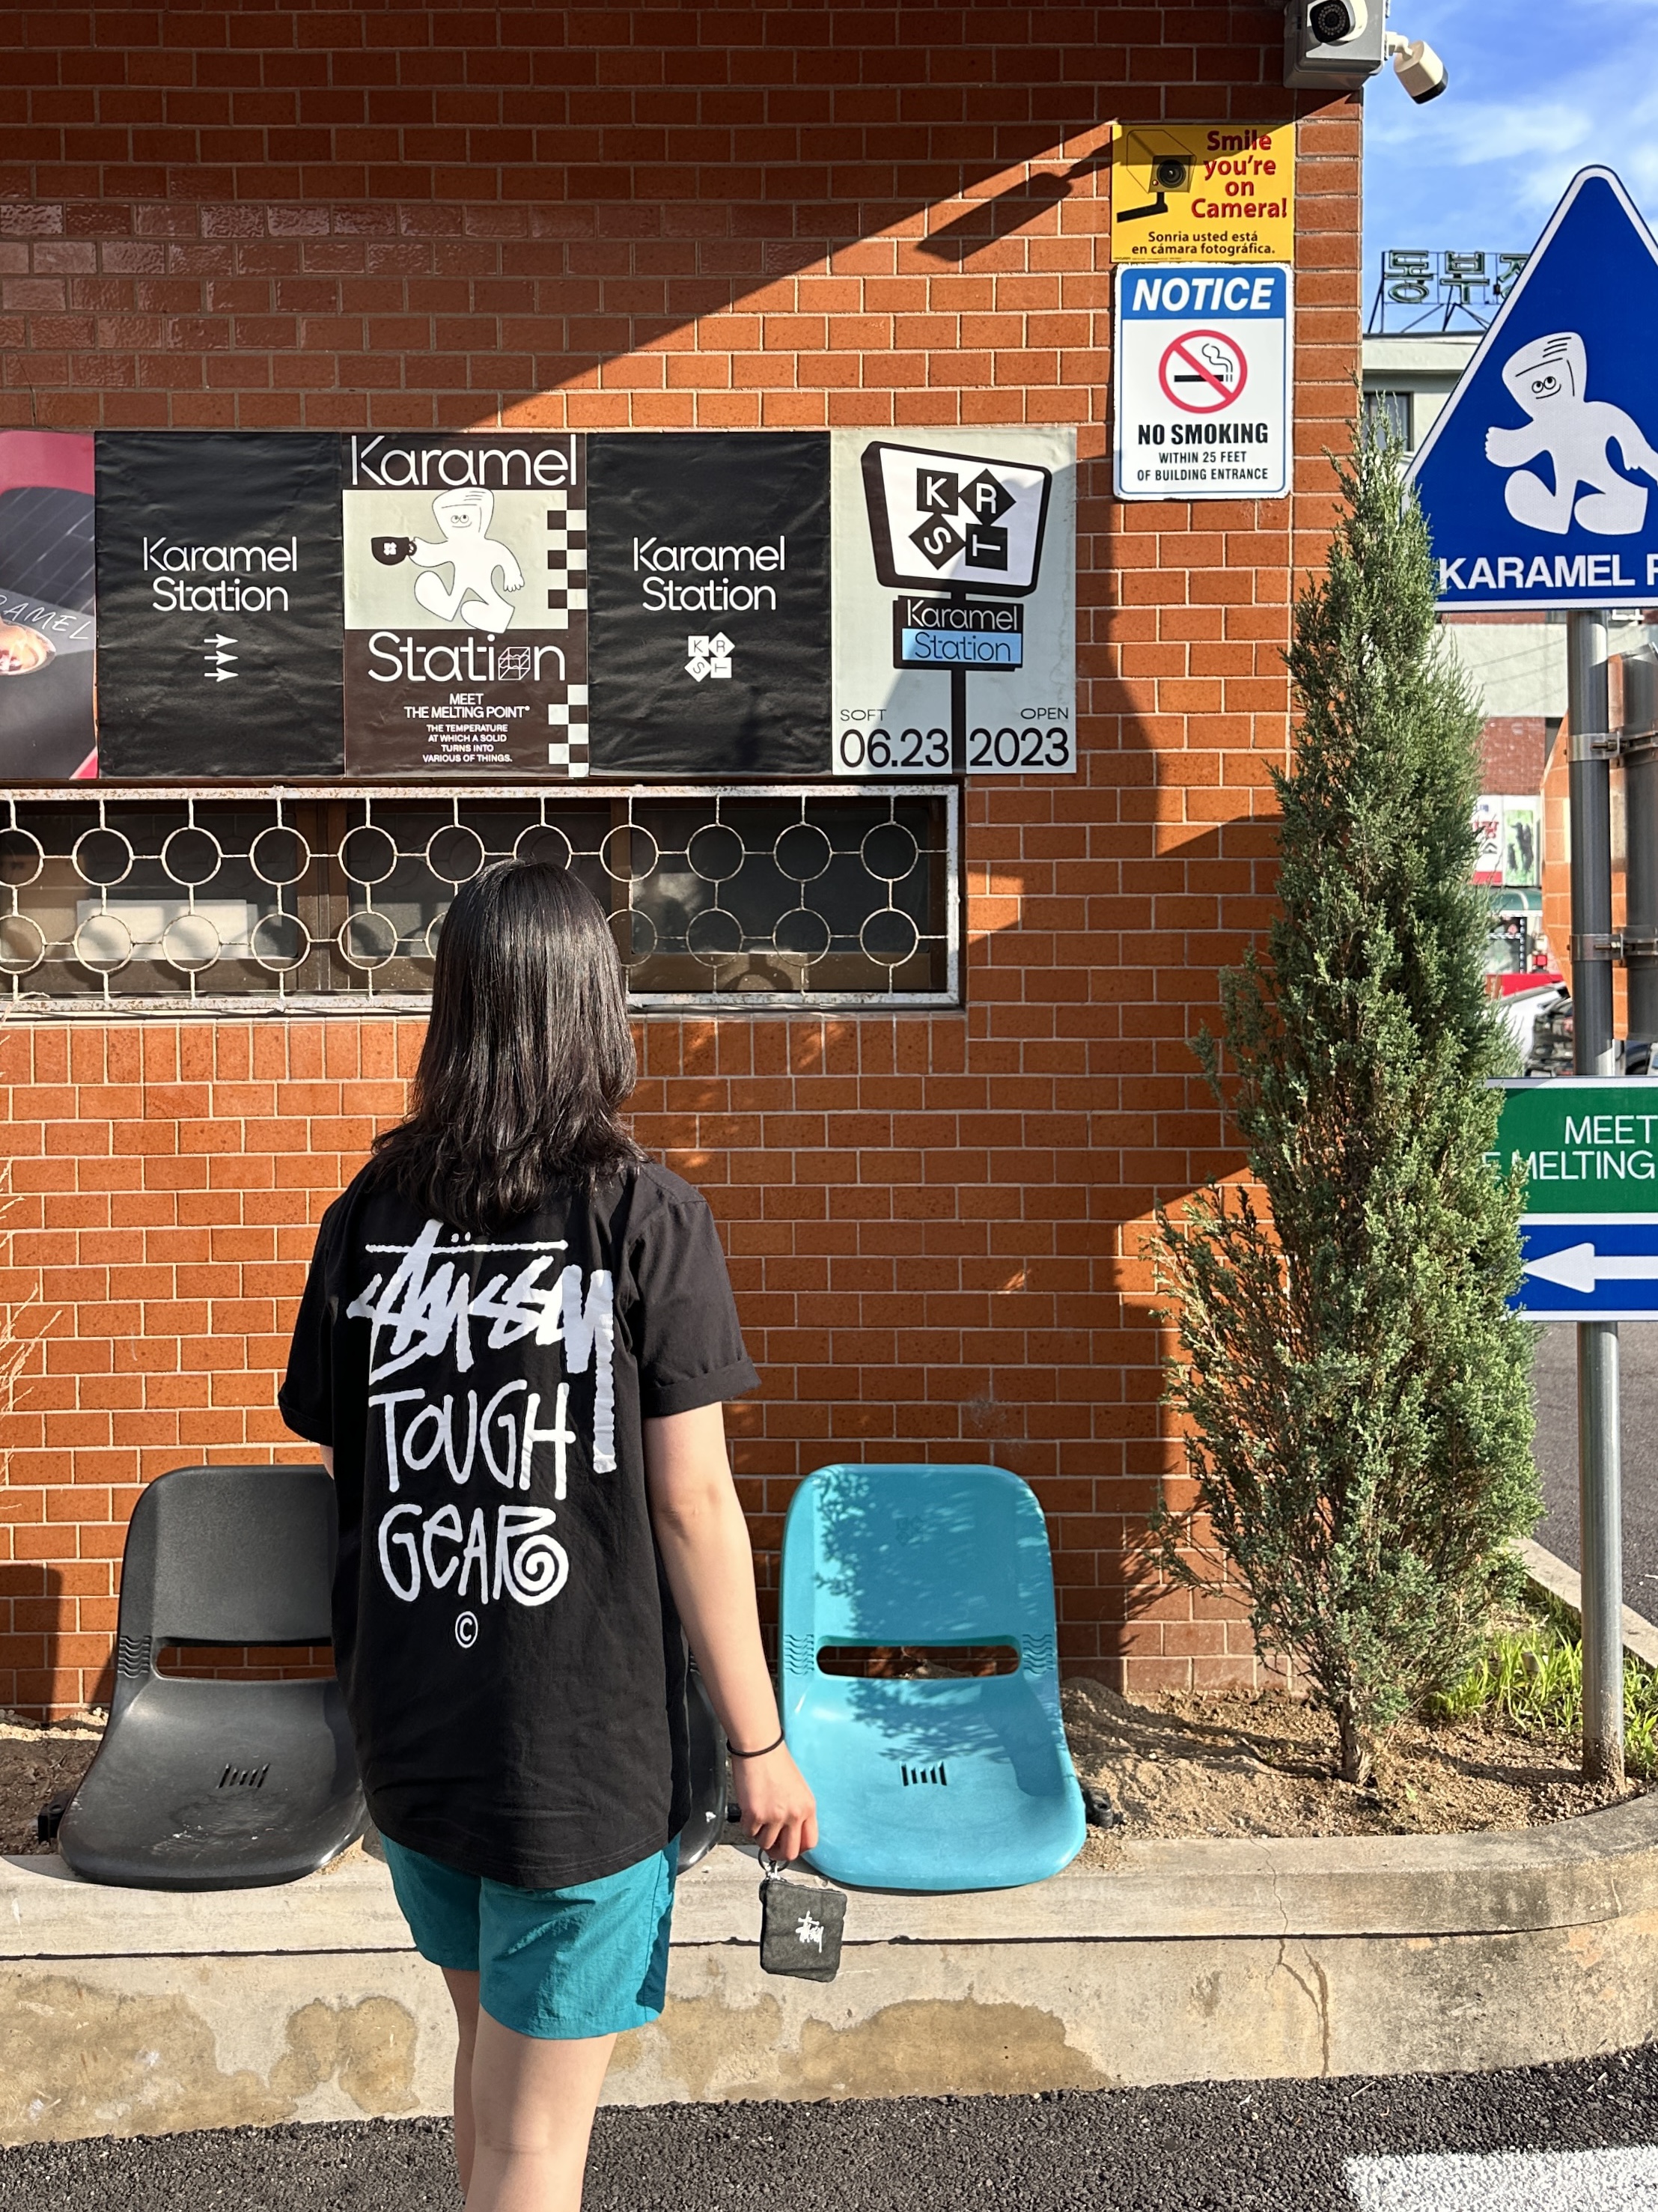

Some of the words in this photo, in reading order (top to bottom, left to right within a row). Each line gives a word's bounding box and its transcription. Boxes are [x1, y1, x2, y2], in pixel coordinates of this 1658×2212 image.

[1207, 130, 1272, 150] Smile
[1204, 155, 1275, 180] you’re
[1225, 180, 1255, 196] on
[1191, 198, 1287, 218] Camera!
[1148, 231, 1189, 242] Sonria
[1192, 231, 1228, 242] usted
[1231, 231, 1258, 242] está
[1132, 245, 1148, 254] en
[1150, 243, 1197, 254] cámara
[1201, 243, 1275, 257] fotográfica.
[1132, 277, 1274, 311] NOTICE
[1138, 424, 1165, 445] NO
[1171, 423, 1268, 445] SMOKING
[351, 434, 577, 487] Karamel
[1159, 451, 1198, 463] WITHIN
[1202, 451, 1216, 463] 25
[1221, 451, 1247, 463] FEET
[1137, 469, 1150, 481] OF
[1155, 469, 1207, 481] BUILDING
[1211, 468, 1268, 480] ENTRANCE
[144, 536, 297, 572] Karamel
[633, 535, 785, 572] Karamel
[1439, 554, 1636, 590] KARAMEL
[153, 576, 289, 612] Station
[642, 576, 776, 612] Station
[906, 600, 1018, 631] Karamel
[915, 631, 1011, 662] Station
[449, 693, 484, 705] MEET
[403, 706, 430, 719] THE
[431, 706, 484, 719] MELTING
[840, 708, 886, 722] SOFT
[1020, 707, 1069, 720] OPEN
[426, 724, 444, 732] THE
[445, 724, 508, 732] TEMPERATURE
[422, 754, 462, 762] VARIOUS
[463, 754, 476, 762] OF
[477, 754, 513, 762] THINGS.
[441, 744, 472, 752] TURNS
[473, 744, 494, 752] INTO
[840, 728, 949, 768] 06.23
[969, 727, 1069, 767] 2023
[1564, 1115, 1658, 1145] MEET
[369, 1380, 576, 1500] TOUGH
